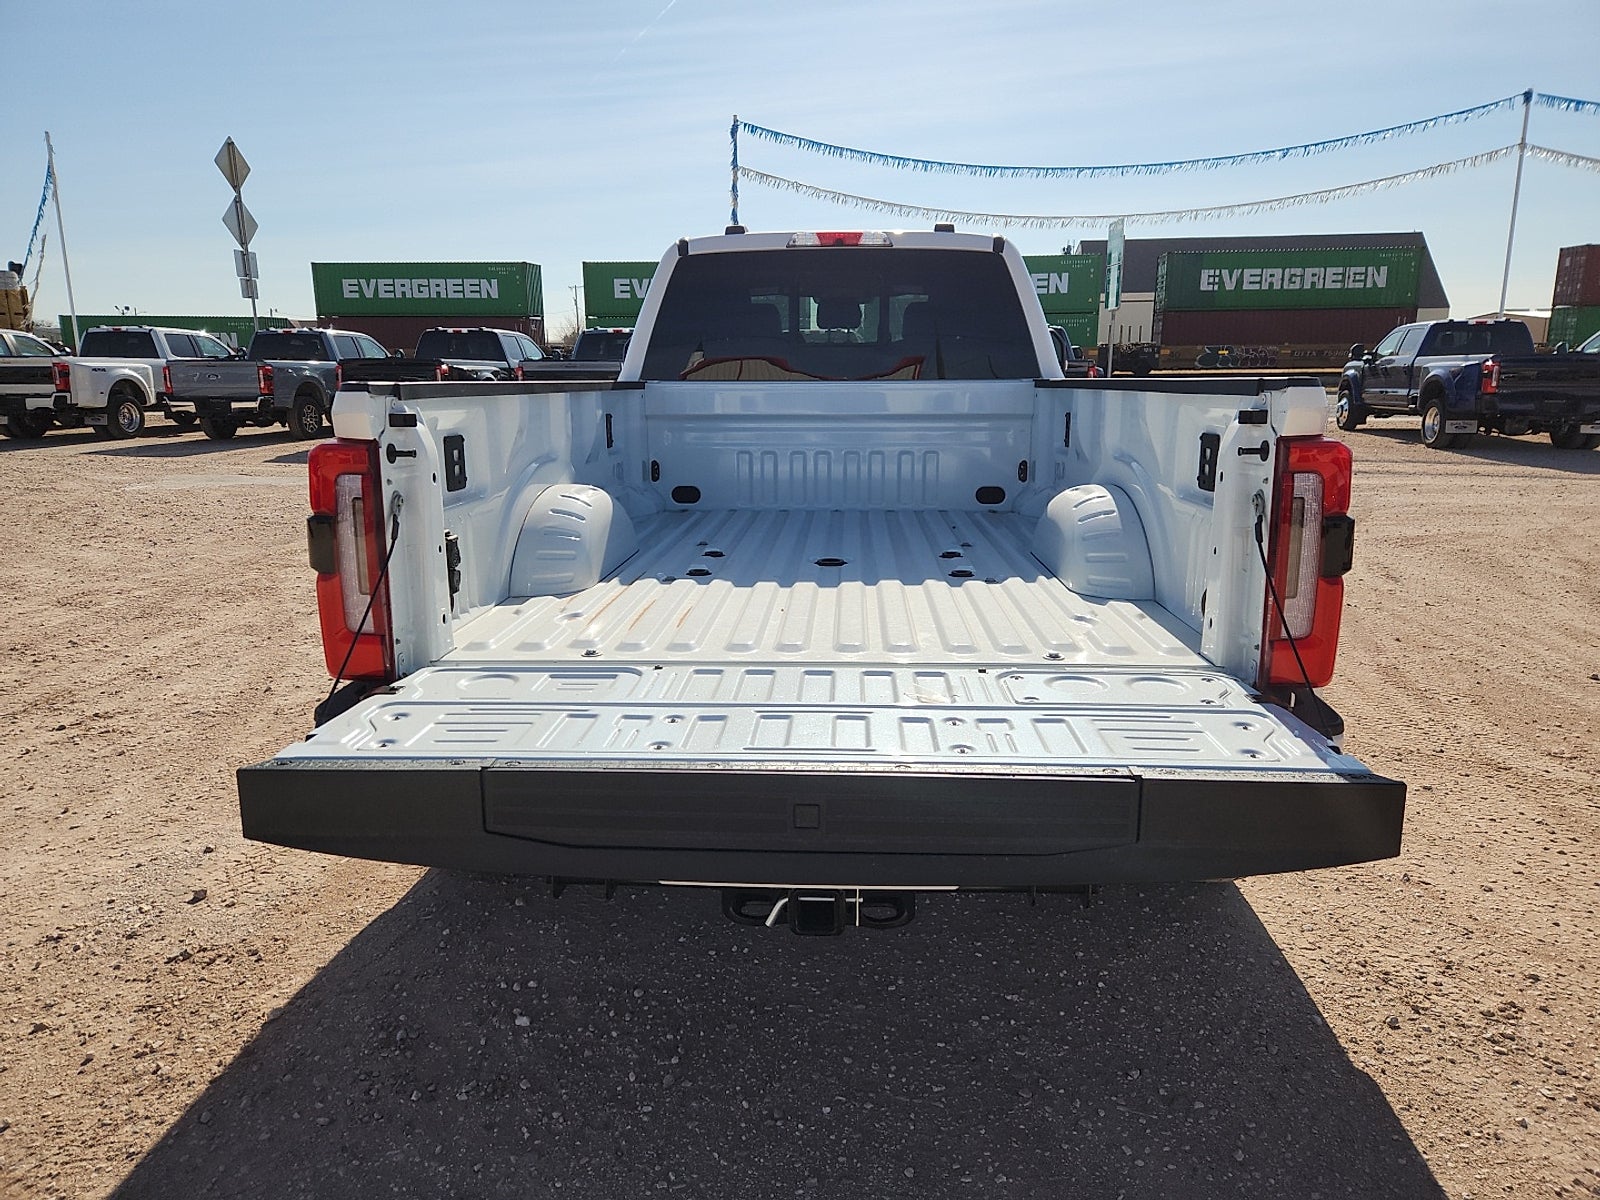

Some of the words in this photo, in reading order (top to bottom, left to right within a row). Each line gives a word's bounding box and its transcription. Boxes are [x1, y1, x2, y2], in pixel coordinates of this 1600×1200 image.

[342, 278, 499, 299] EVERGREEN
[613, 278, 653, 299] EV
[1200, 265, 1388, 291] EVERGREEN
